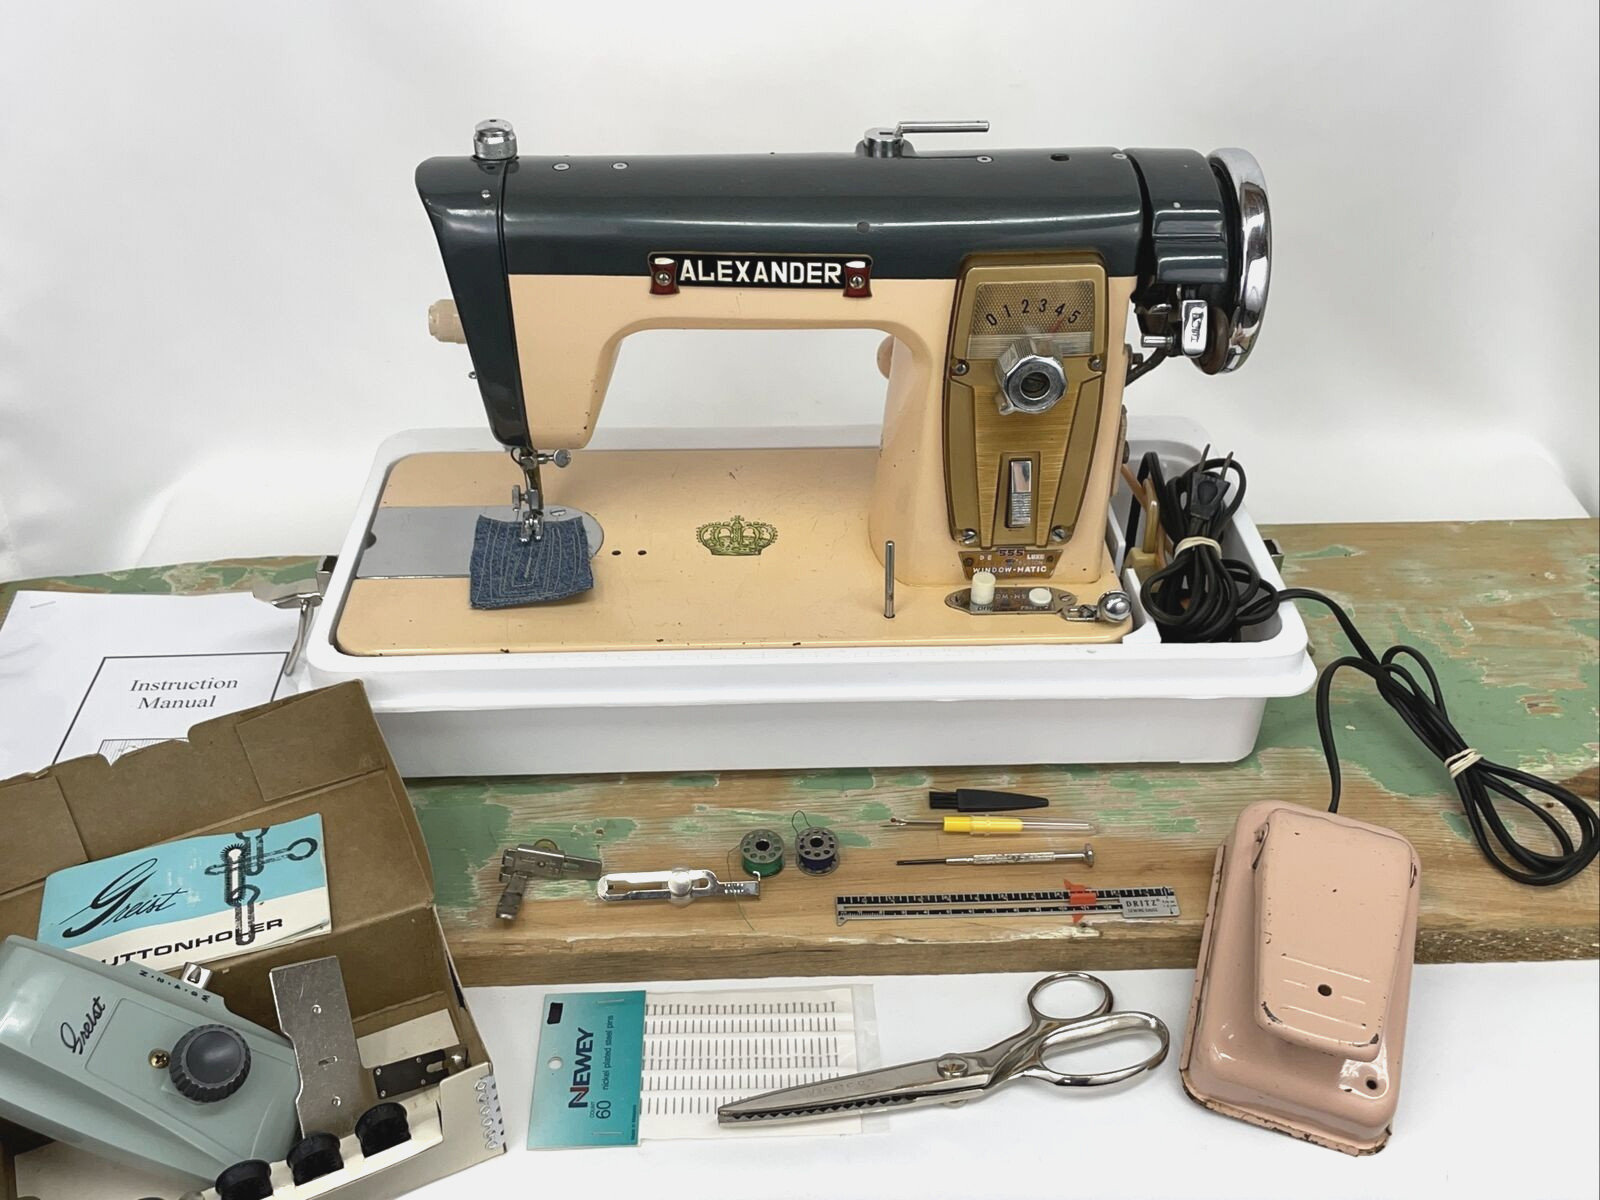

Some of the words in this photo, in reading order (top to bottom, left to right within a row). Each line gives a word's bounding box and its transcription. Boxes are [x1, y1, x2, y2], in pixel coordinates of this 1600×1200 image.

[679, 259, 842, 284] ALEXANDER
[986, 313, 997, 325] 0
[1003, 304, 1011, 317] 1
[1021, 298, 1030, 313] 2
[1039, 298, 1047, 312] 3
[1055, 303, 1066, 316] 4
[1067, 309, 1080, 323] 5
[999, 549, 1024, 557] 555
[130, 677, 239, 692] Instruction
[137, 695, 217, 709] Manual
[59, 858, 188, 938] Greist
[607, 1015, 615, 1029] pins
[605, 1030, 613, 1046] steel
[604, 1047, 612, 1068] plated
[568, 1027, 594, 1109] NEWEY
[602, 1070, 610, 1091] nickel
[595, 1100, 611, 1120] 60
